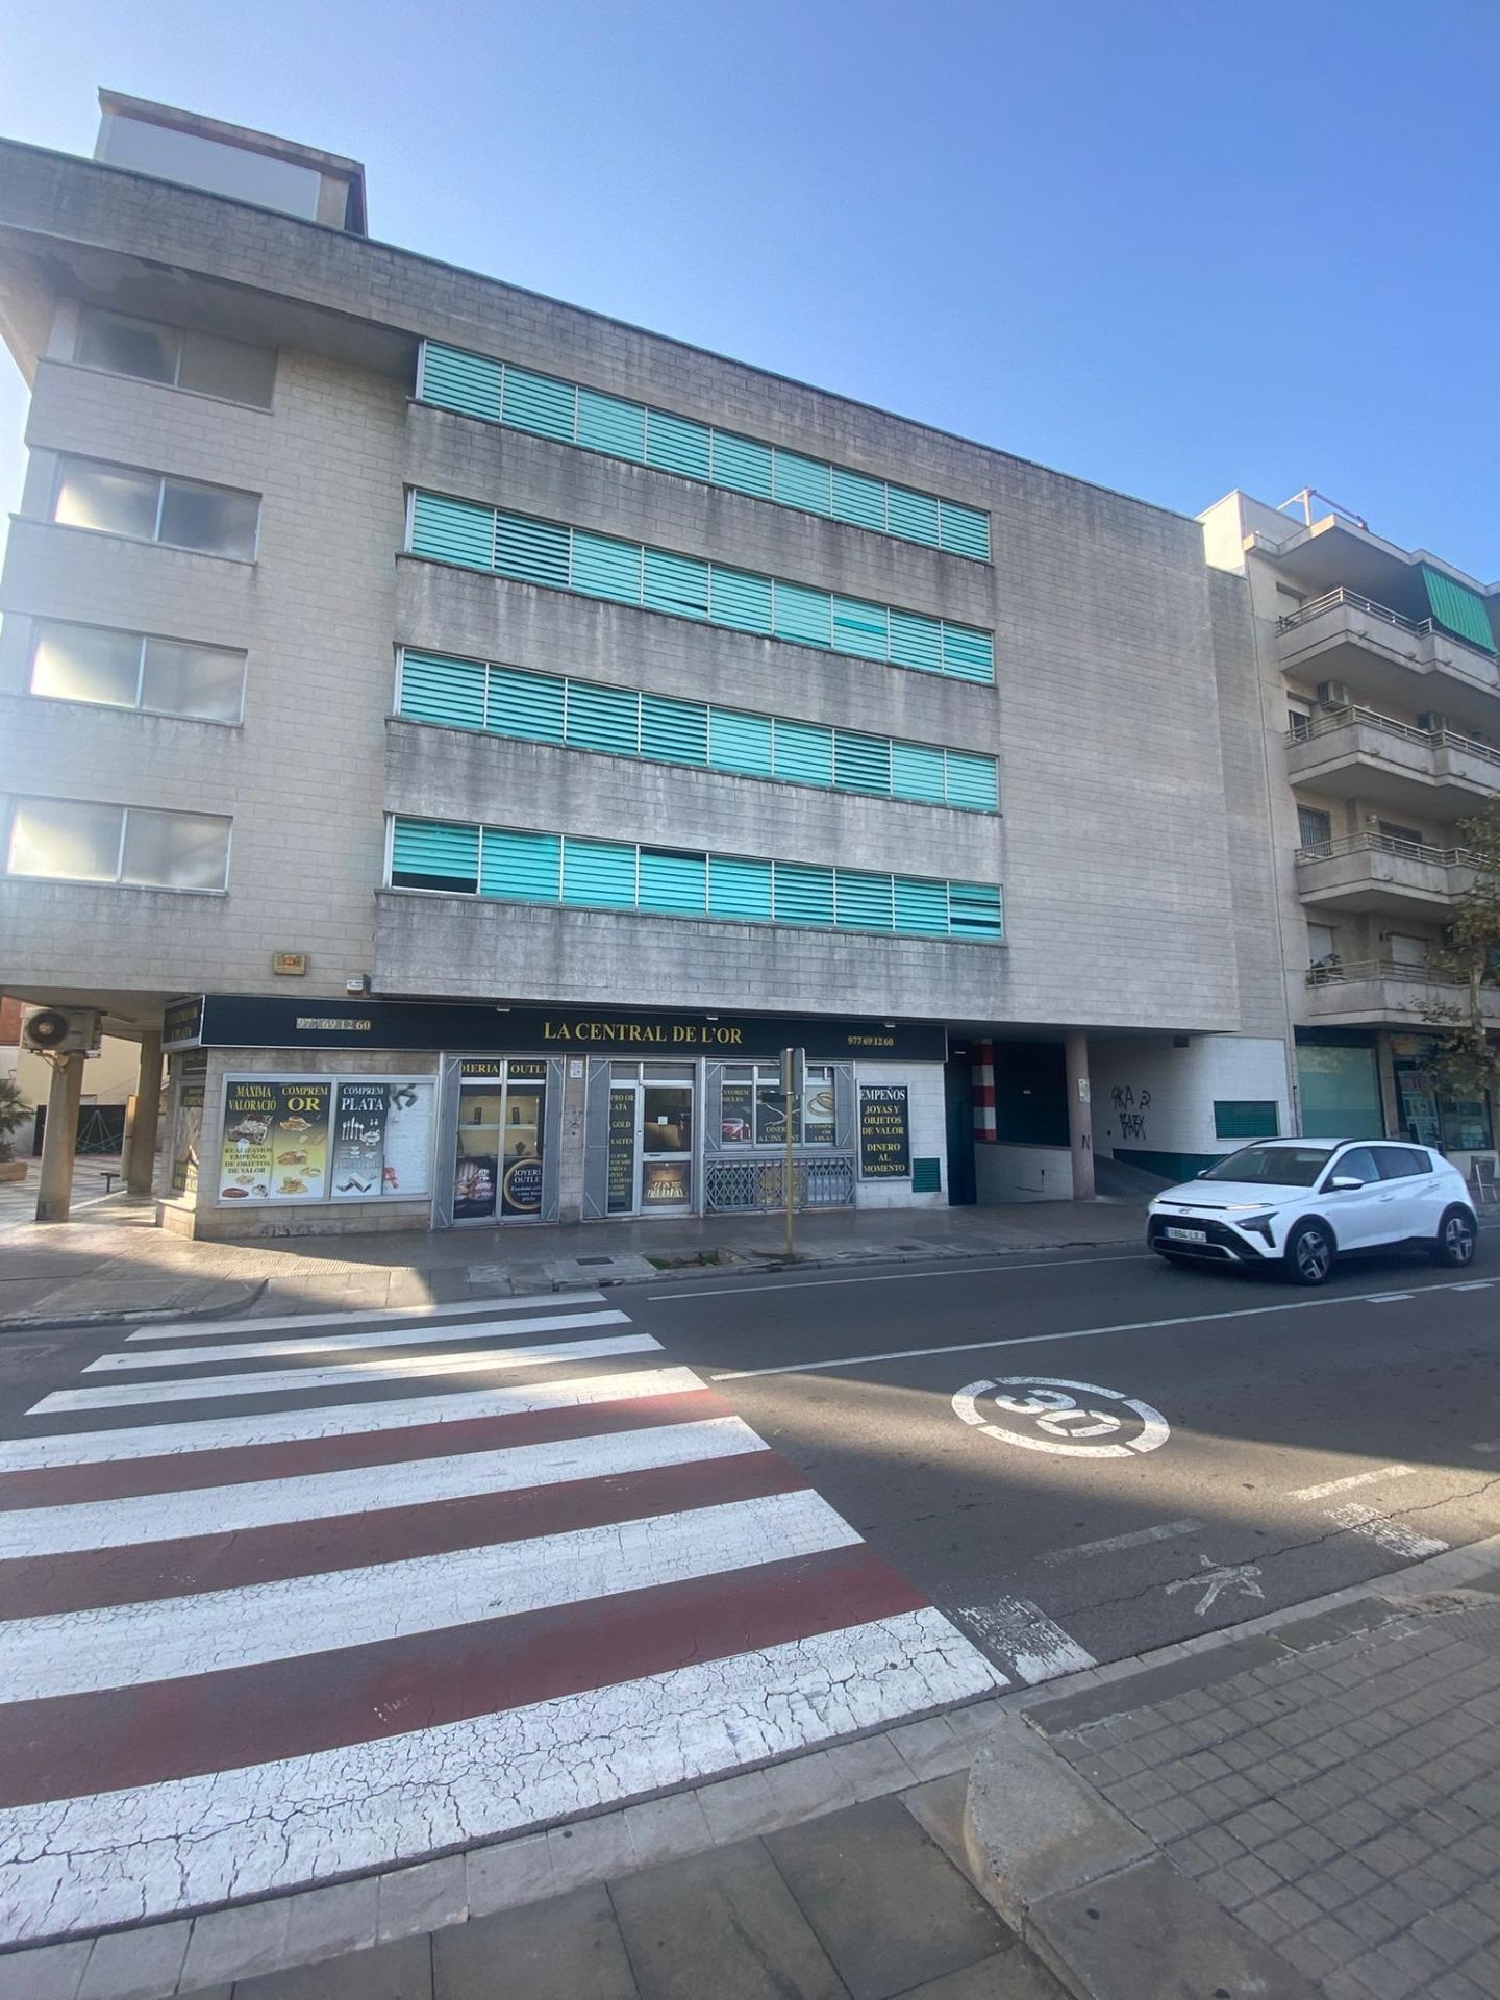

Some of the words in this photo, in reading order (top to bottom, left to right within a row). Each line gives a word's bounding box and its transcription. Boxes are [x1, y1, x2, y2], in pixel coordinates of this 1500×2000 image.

[356, 1020, 371, 1030] 60
[543, 1021, 571, 1040] LA
[575, 1022, 667, 1042] CENTRAL
[672, 1025, 697, 1043] DE
[701, 1027, 742, 1044] L'OR
[281, 1086, 328, 1096] COMPREM
[343, 1087, 384, 1096] COMPREM
[859, 1086, 906, 1100] EMPEÑOS
[228, 1096, 277, 1111] VALORACIÓ
[287, 1097, 321, 1111] OR
[341, 1097, 384, 1111] PLATA
[865, 1105, 893, 1114] JOYAS
[894, 1105, 900, 1113] Y
[864, 1116, 902, 1125] OBJETOS
[862, 1126, 874, 1135] DE
[875, 1126, 904, 1134] VALOR
[867, 1143, 900, 1151] DINERO
[878, 1153, 891, 1161] AL
[514, 1168, 542, 1177] JOYERI
[864, 1164, 905, 1173] MOMENTO
